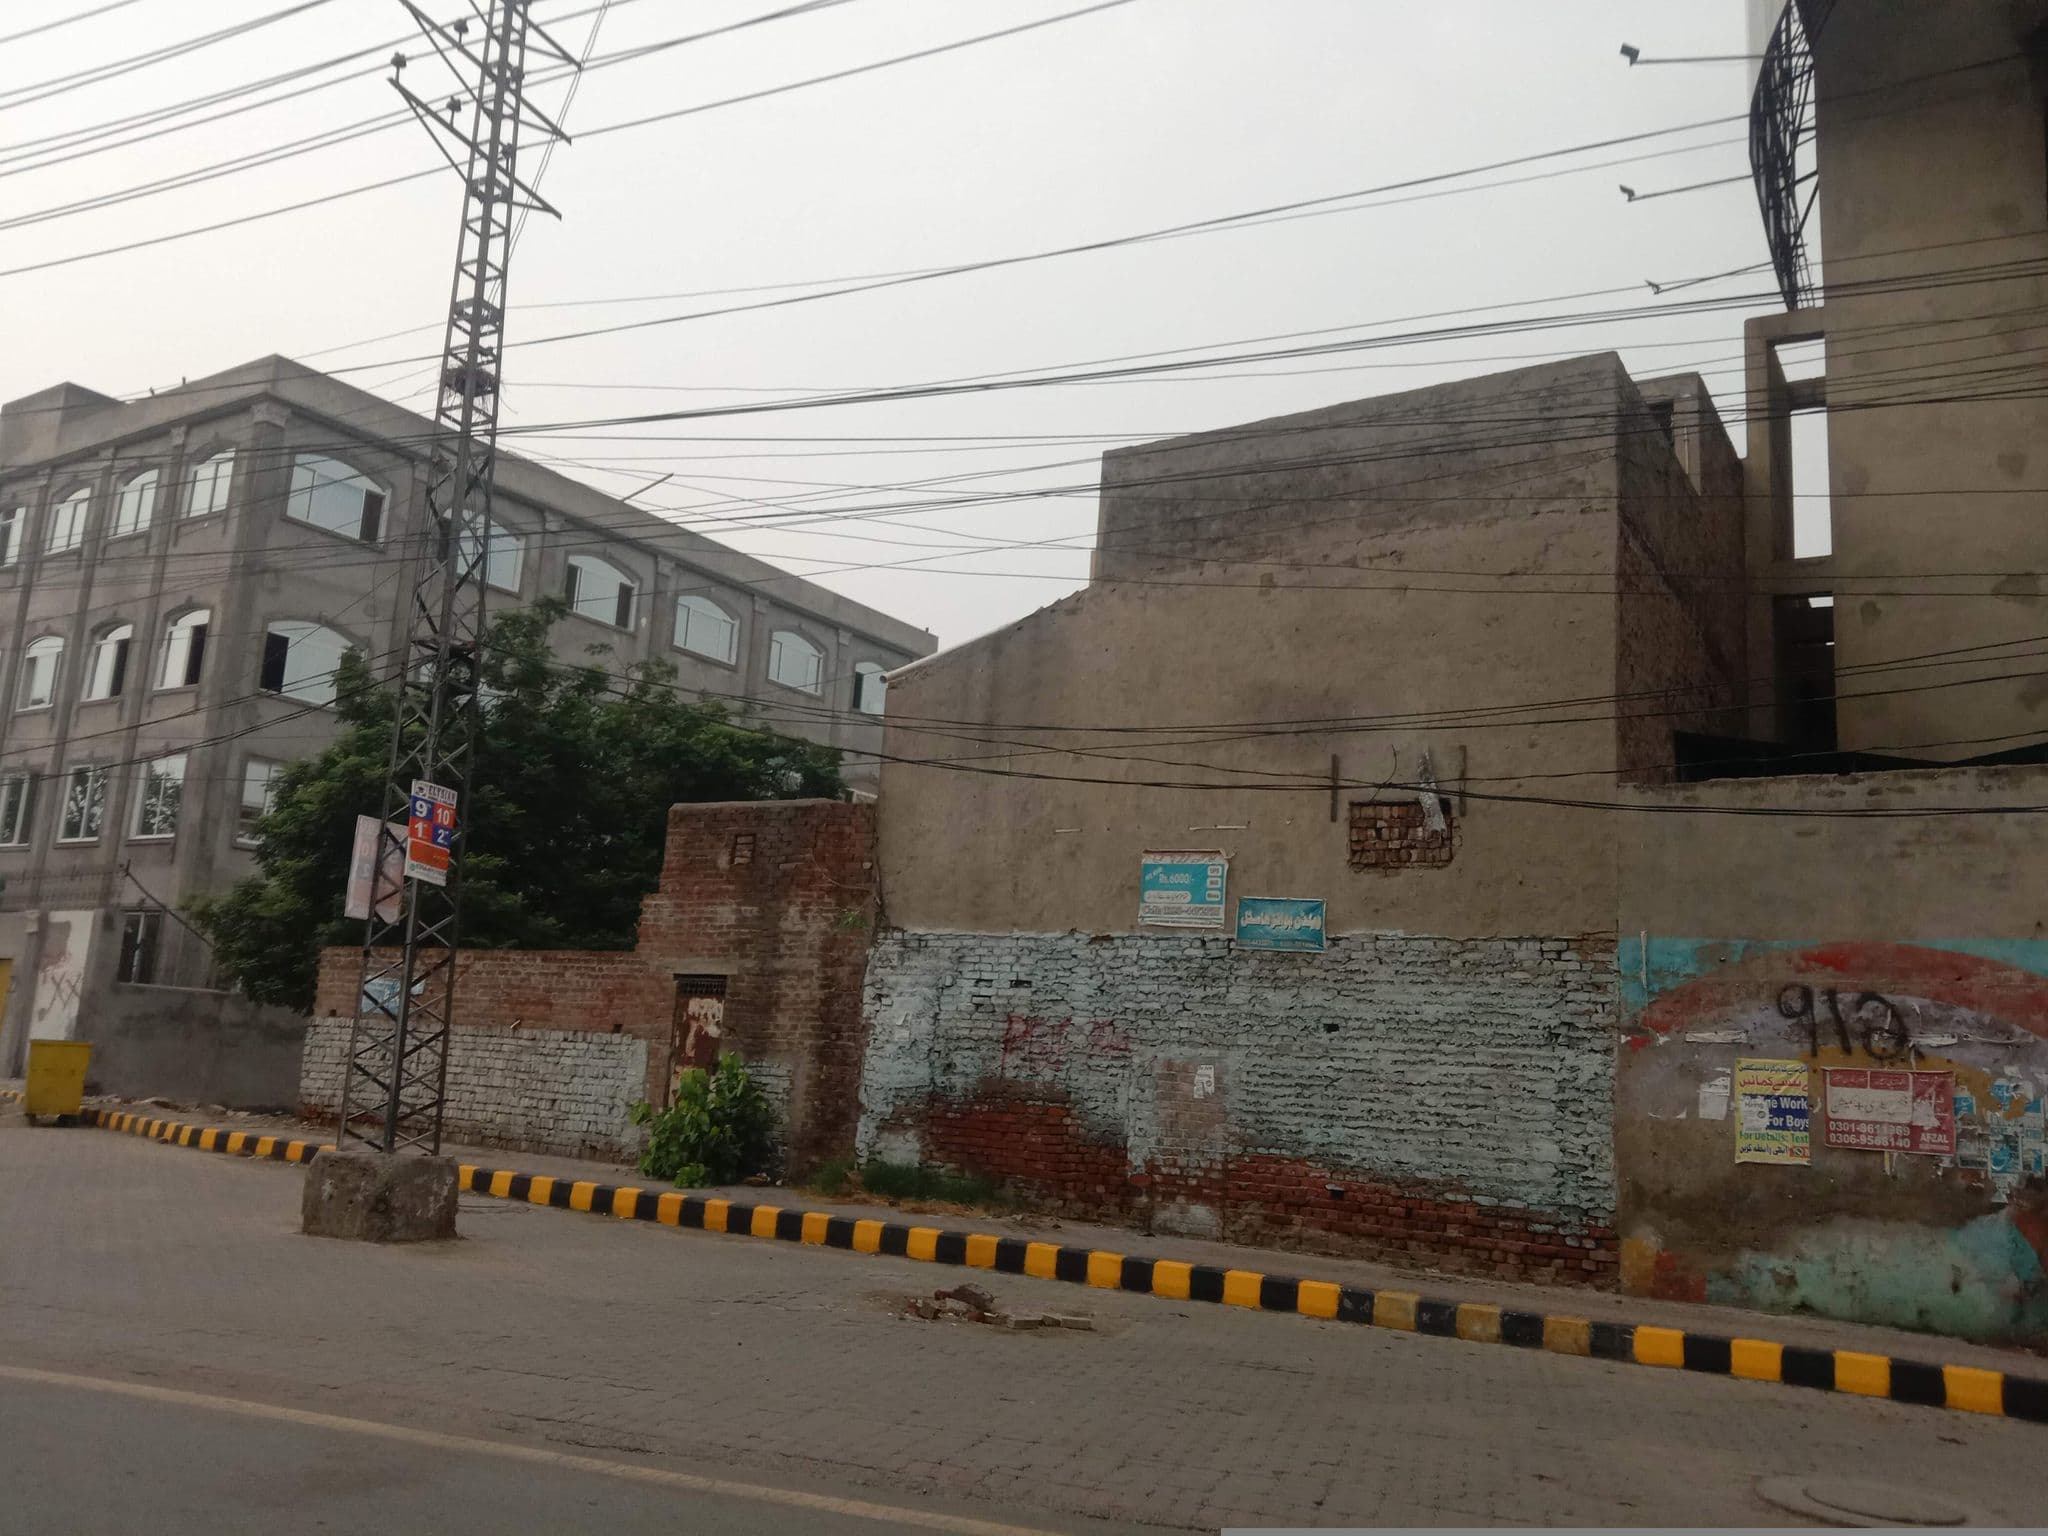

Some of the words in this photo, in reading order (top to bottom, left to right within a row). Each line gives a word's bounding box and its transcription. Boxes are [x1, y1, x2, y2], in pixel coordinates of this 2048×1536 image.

[1780, 1097, 1809, 1110] Work
[1786, 1115, 1809, 1130] Boys
[1791, 1132, 1809, 1144] Text
[1920, 1132, 1949, 1144] AFZAL
